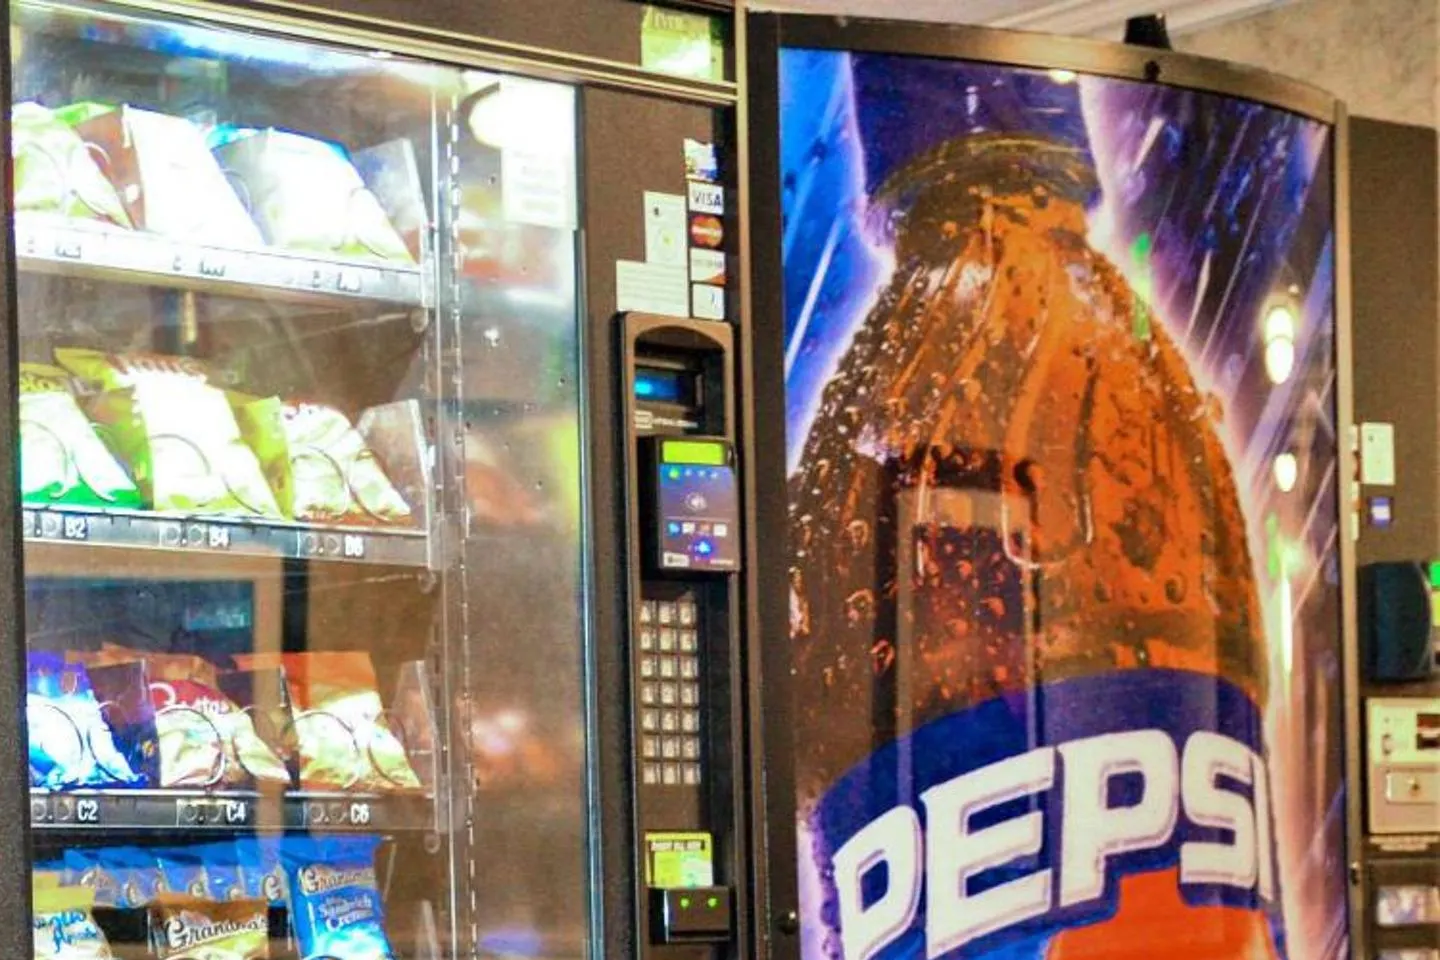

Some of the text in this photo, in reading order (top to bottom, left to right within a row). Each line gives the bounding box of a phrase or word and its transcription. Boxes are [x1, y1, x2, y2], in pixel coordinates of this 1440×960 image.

[77, 800, 99, 821] C2
[225, 801, 246, 823] C4
[350, 803, 370, 823] C6
